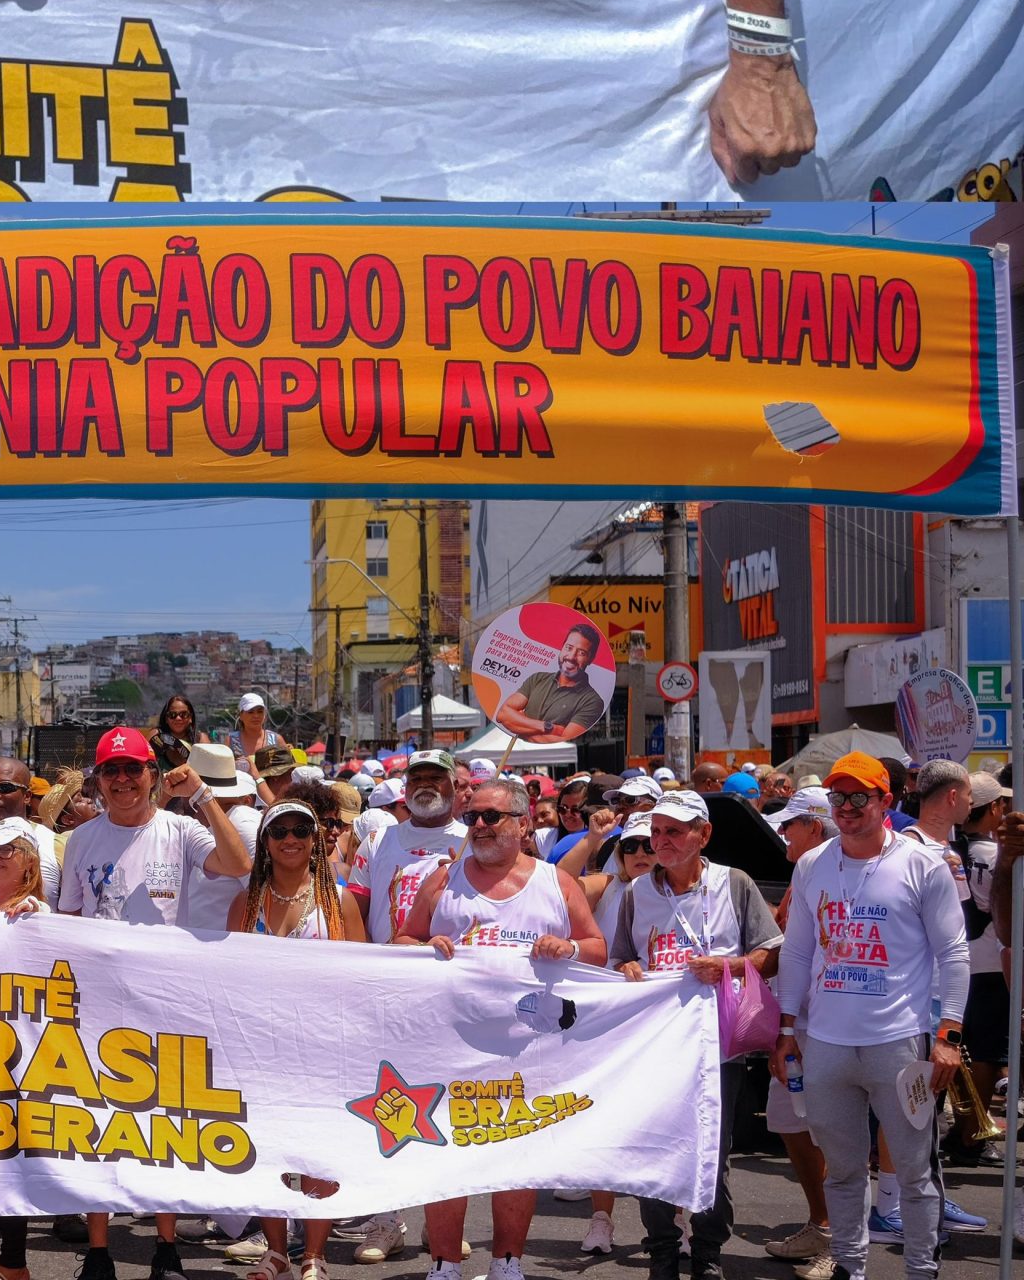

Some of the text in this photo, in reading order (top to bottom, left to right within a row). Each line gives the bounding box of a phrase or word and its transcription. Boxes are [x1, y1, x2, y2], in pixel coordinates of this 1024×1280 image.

[747, 17, 771, 29] 2026
[289, 252, 405, 349] DO
[423, 254, 641, 357] POVO
[659, 261, 921, 371] BAIANO
[145, 356, 554, 458] POPULAR
[573, 596, 664, 614] Auto Nív
[738, 591, 779, 641] VITAL
[493, 629, 556, 659] Emprego, dignidade
[495, 639, 549, 666] desenvolvimento
[485, 647, 502, 658] para
[506, 652, 529, 668] Bahia!
[906, 671, 937, 688] Empresa
[978, 671, 994, 694] E
[977, 714, 996, 738] D
[144, 878, 168, 886] COM
[400, 873, 420, 891] FÉ
[867, 905, 887, 917] NÃO
[478, 926, 539, 940] FÉ QUE NÃO
[657, 929, 677, 952] FÉ
[868, 922, 880, 939] À
[824, 981, 844, 989] CUT
[825, 970, 867, 982] COM O POVO
[448, 1072, 525, 1099] COMITÊ
[449, 1091, 589, 1128] BRASIL
[452, 1097, 594, 1147] SOBERANO
